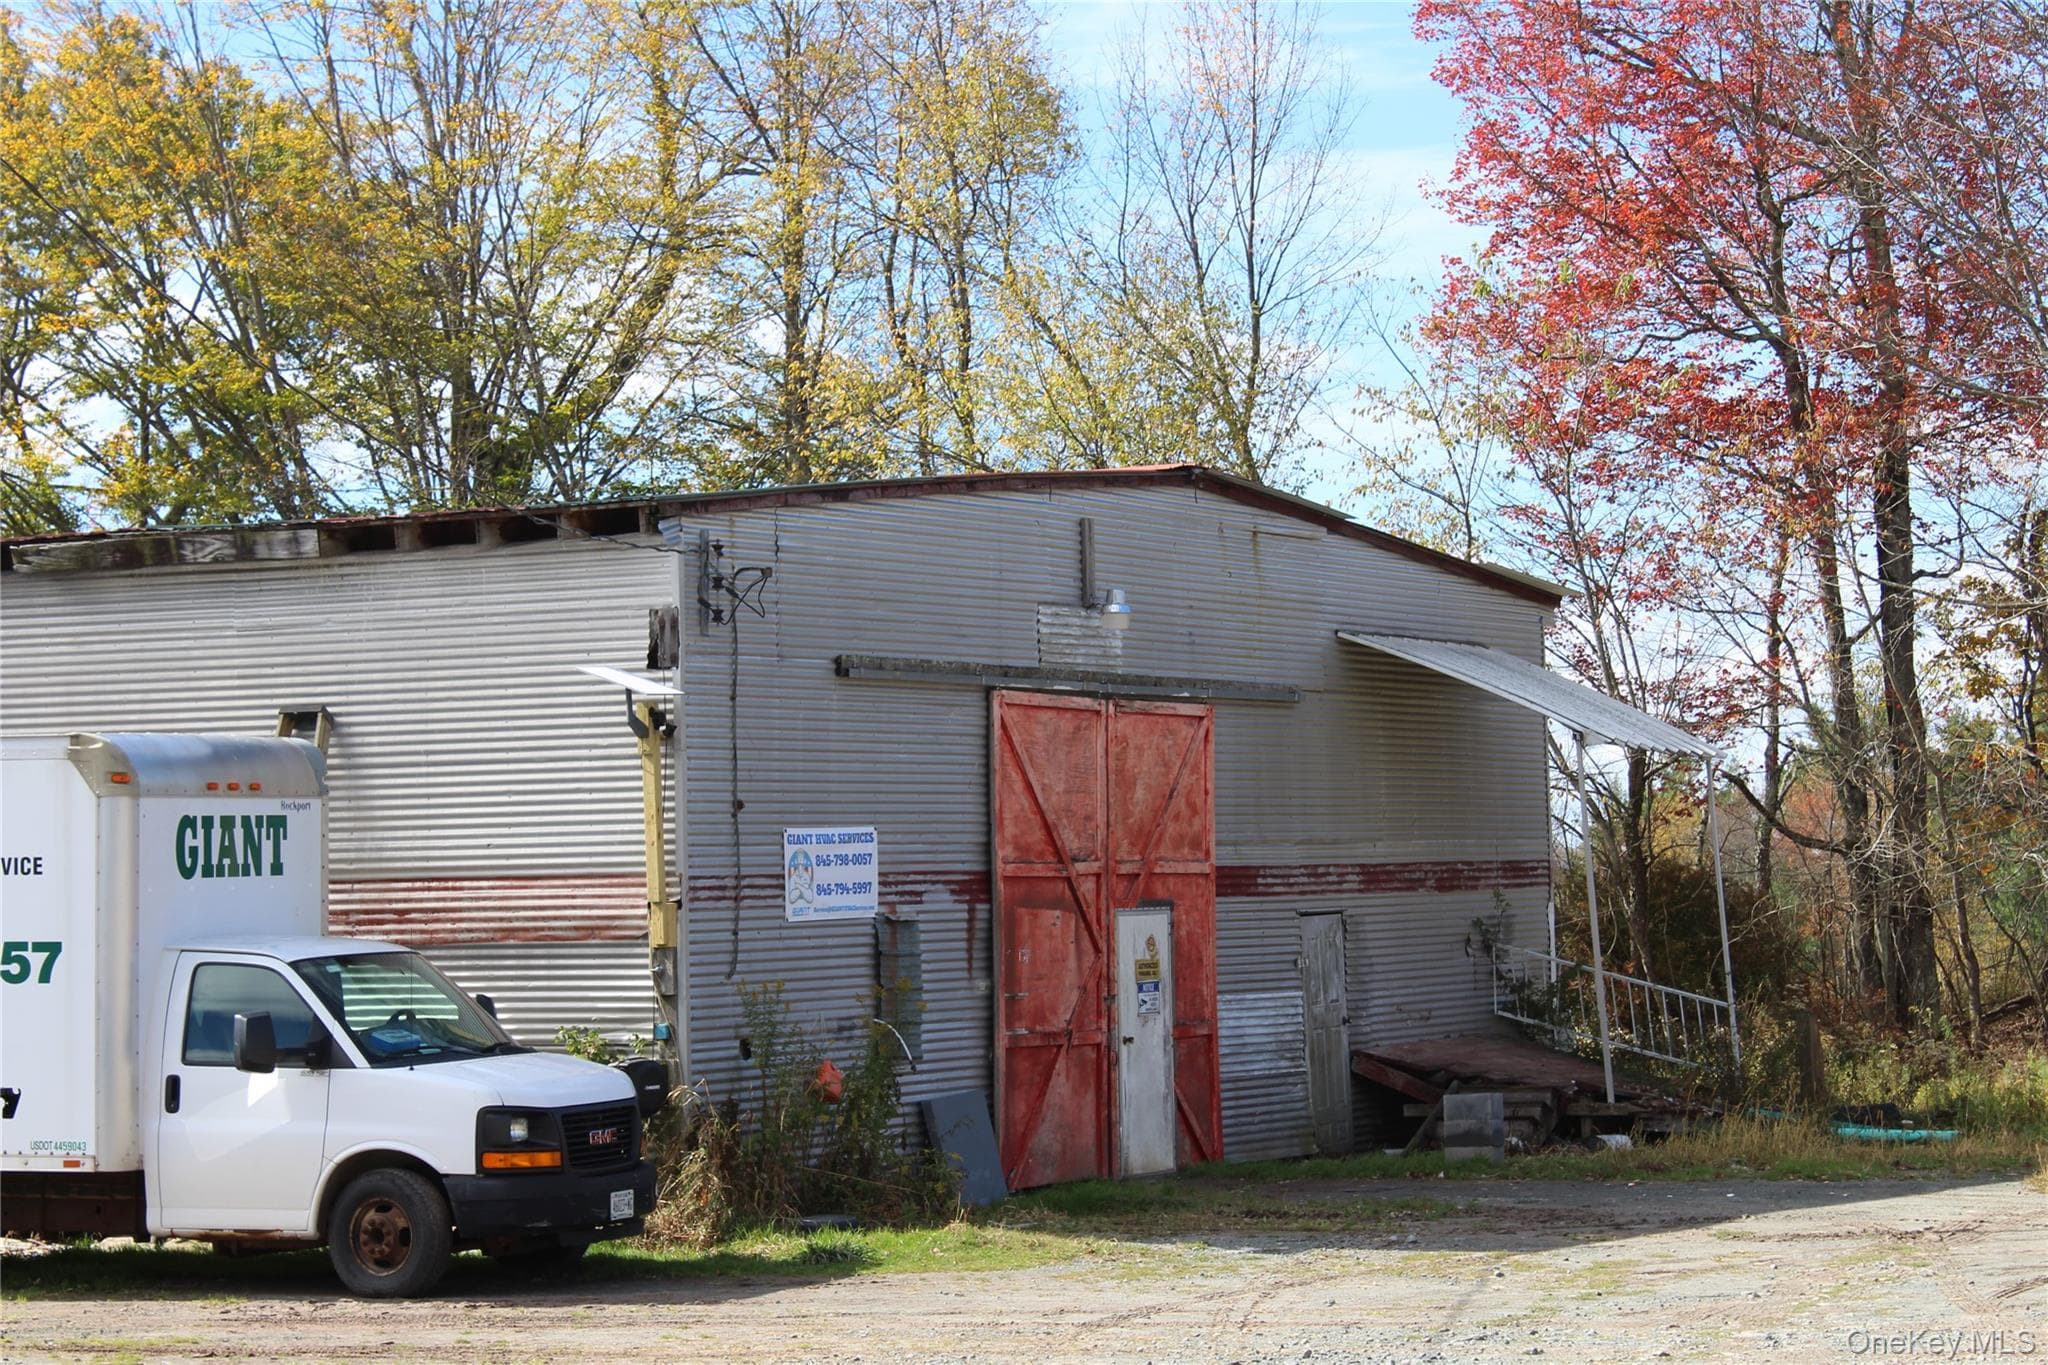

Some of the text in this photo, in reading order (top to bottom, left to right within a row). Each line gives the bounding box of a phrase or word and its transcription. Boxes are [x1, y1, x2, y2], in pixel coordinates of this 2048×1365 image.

[787, 832, 874, 845] GIANT HVAC SERVICES
[176, 814, 287, 880] GIANT
[815, 853, 872, 867] 845-798-0057
[816, 882, 872, 896] 845-794-5997
[0, 941, 62, 984] 57
[590, 1128, 617, 1145] GMC
[31, 1140, 87, 1151] USDOT 4459043
